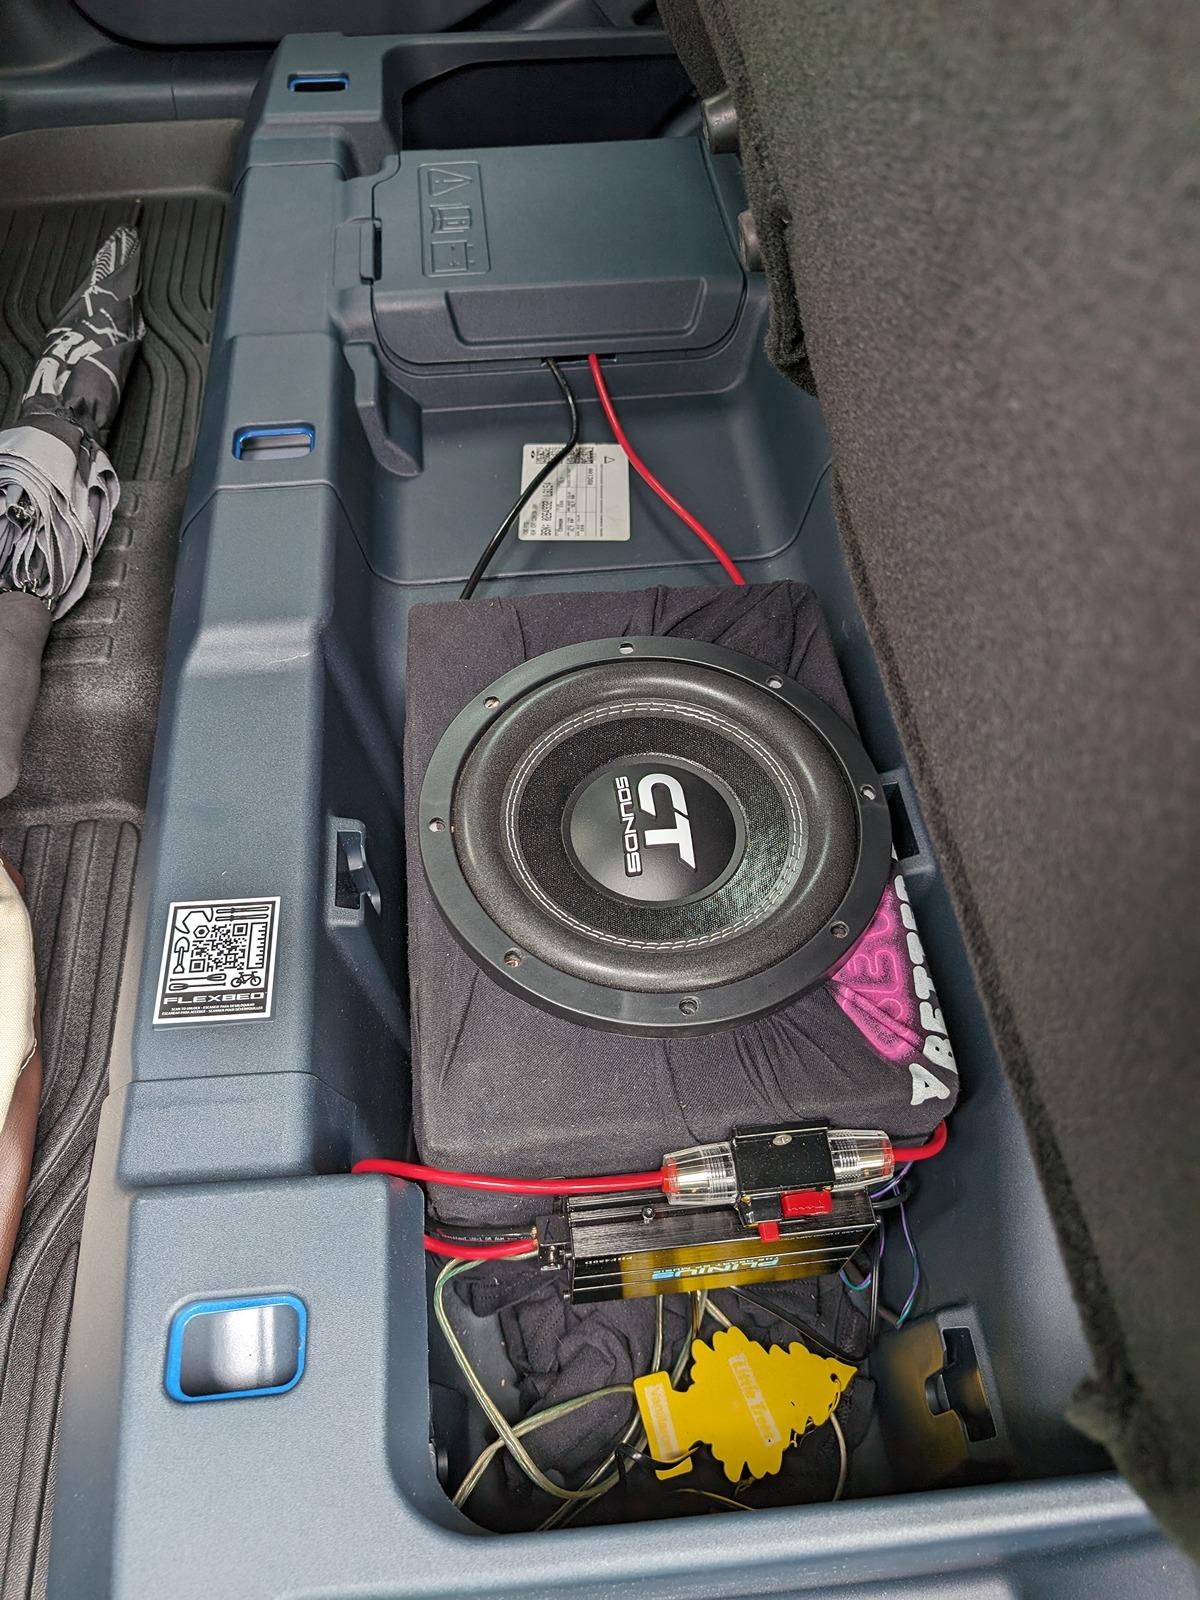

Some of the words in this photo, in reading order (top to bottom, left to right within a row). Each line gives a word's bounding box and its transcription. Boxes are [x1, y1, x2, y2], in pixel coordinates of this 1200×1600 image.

[615, 776, 641, 873] SOUNDS
[637, 773, 696, 869] CT
[163, 992, 265, 1005] FLEXBED
[652, 1258, 779, 1280] PLINIUS
